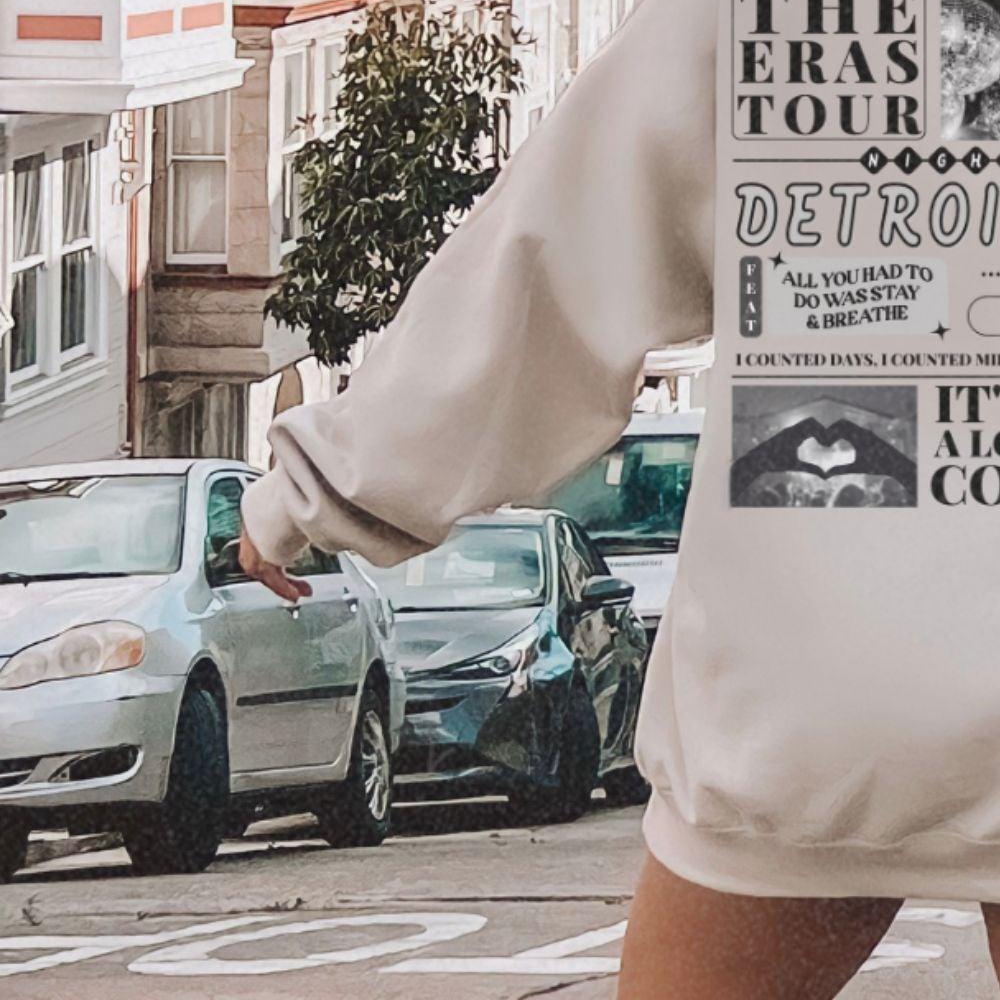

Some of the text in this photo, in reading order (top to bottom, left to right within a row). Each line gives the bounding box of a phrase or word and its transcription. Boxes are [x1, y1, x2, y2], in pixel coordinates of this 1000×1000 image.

[739, 40, 919, 84] ERAS
[737, 94, 921, 136] TOUR
[782, 264, 933, 289] ALL YOU HAD TO
[745, 263, 758, 332] FEAT
[794, 284, 920, 310] DO WAS STAY
[806, 304, 909, 329] & BREATHE
[736, 353, 741, 366] I
[745, 353, 827, 367] COUNTED
[831, 353, 878, 367] DAYS,
[882, 353, 887, 366] I
[890, 353, 972, 366] COUNTED
[934, 430, 960, 458] A
